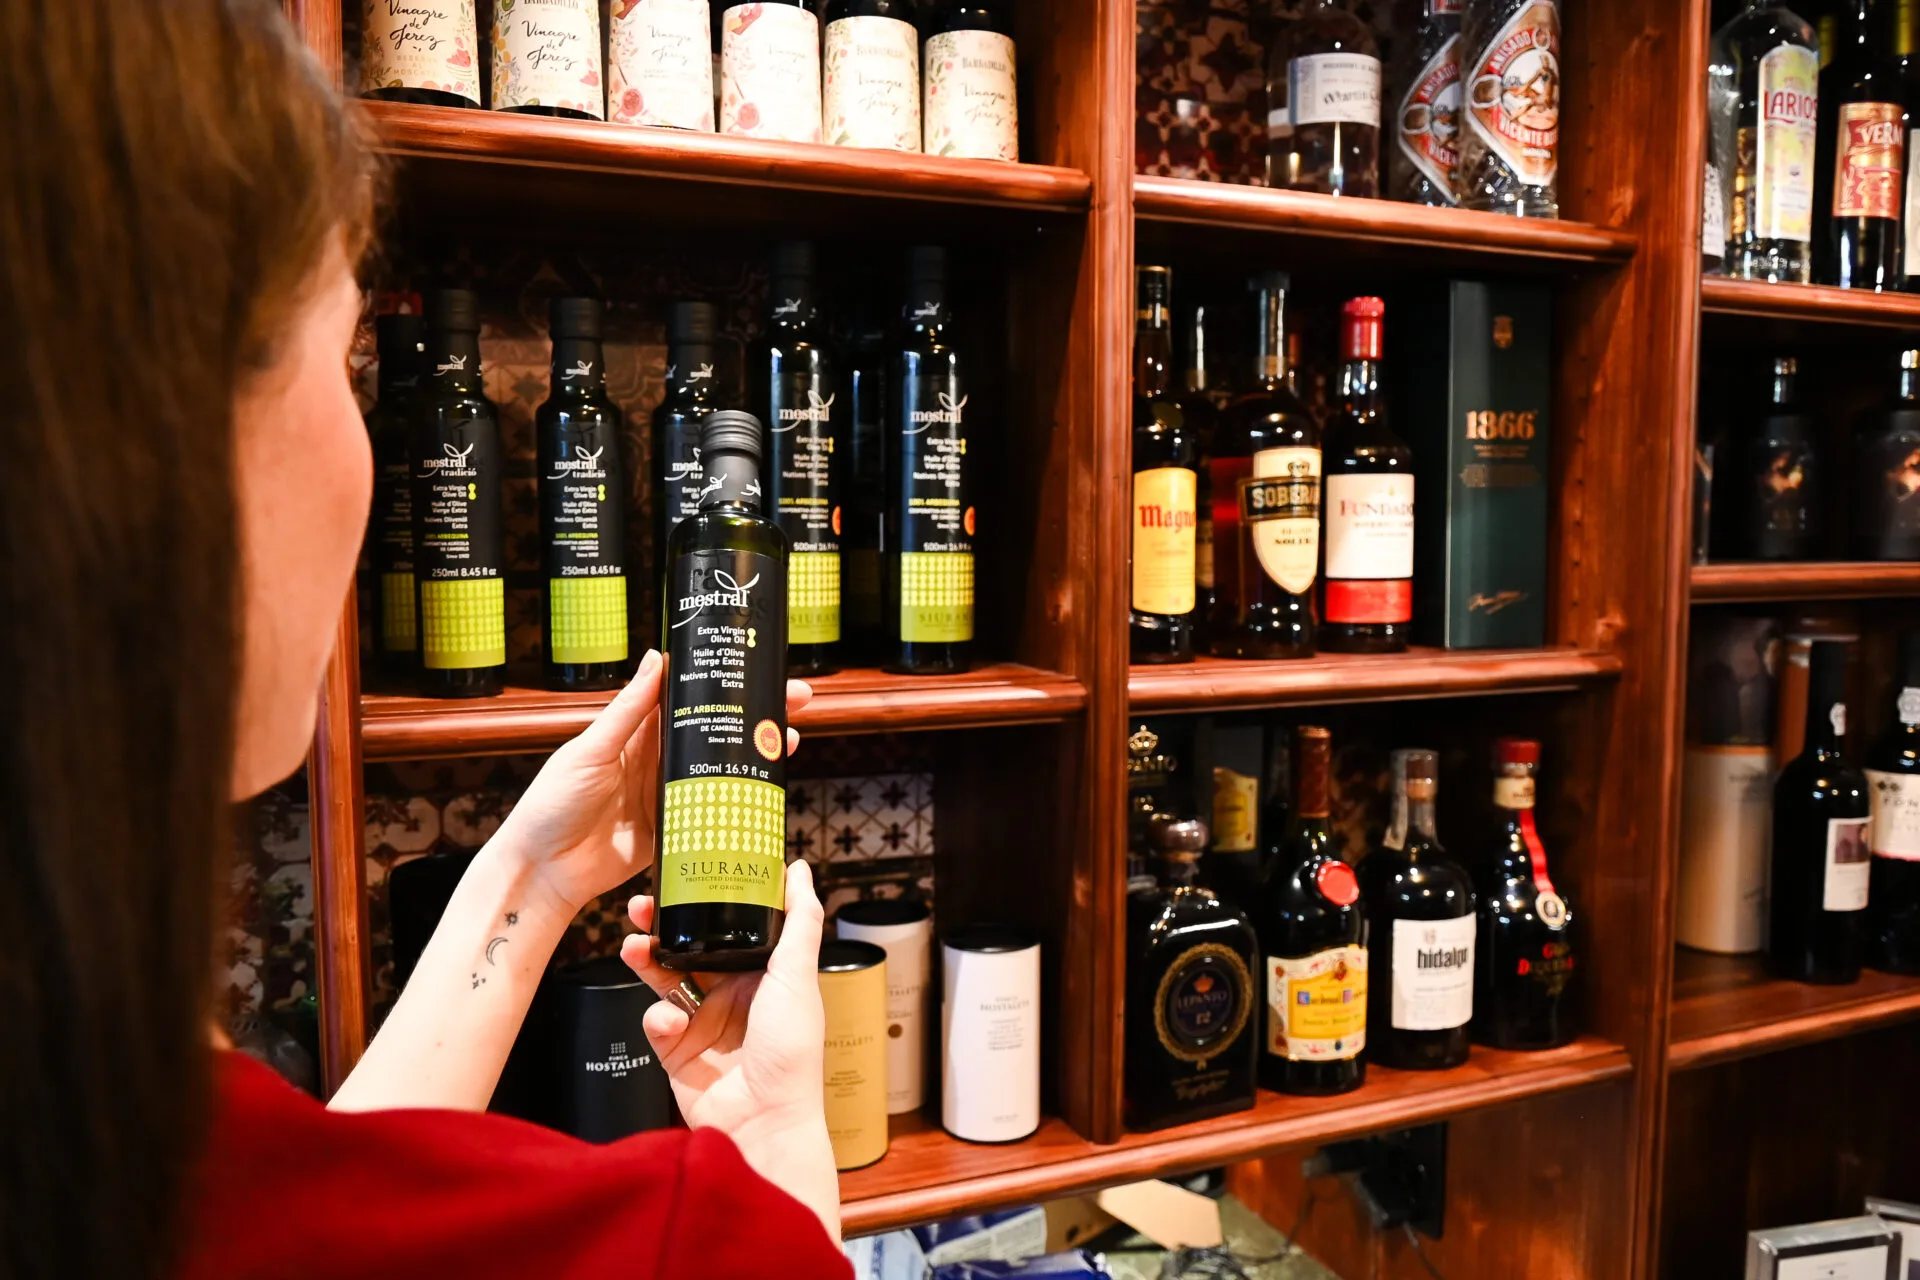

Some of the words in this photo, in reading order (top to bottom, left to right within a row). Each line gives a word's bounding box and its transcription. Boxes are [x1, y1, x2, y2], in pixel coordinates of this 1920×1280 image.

[384, 0, 448, 26] Vinagre
[521, 20, 581, 47] Vinagre
[778, 407, 830, 422] mestral
[910, 409, 962, 424] mestral
[1466, 409, 1535, 440] 1866
[423, 455, 467, 468] mestral
[554, 458, 598, 470] mestral
[441, 467, 477, 477] tradició
[432, 568, 459, 577] 250ml
[460, 566, 482, 577] 8.45
[561, 565, 588, 576] 250ml
[590, 565, 609, 575] 8.45
[679, 589, 750, 612] mestral
[697, 626, 719, 635] Extra
[720, 626, 745, 637] Virgin
[710, 635, 732, 644] Olive
[733, 635, 745, 645] Oil
[693, 649, 714, 658] Huile
[716, 648, 745, 658] d'Olive
[693, 658, 720, 667] Vierge
[722, 657, 745, 667] Extra
[680, 670, 708, 682] Natives
[710, 669, 745, 680] Olivenöl
[721, 679, 744, 689] Extra
[673, 706, 692, 718] 100%
[693, 704, 744, 714] ARBEQUINA
[673, 716, 712, 728] COOPERATIVA
[712, 715, 744, 725] AGRÍCOLA
[700, 724, 710, 732] DE
[710, 724, 744, 733] CAMBRILS
[708, 736, 726, 744] Since
[726, 736, 743, 744] 1902
[689, 763, 722, 775] 500ml
[724, 763, 749, 775] 16.9
[751, 765, 758, 777] fl
[759, 769, 769, 779] oz
[680, 860, 770, 880] SIURANA
[685, 875, 723, 884] PROTECTED
[824, 1036, 874, 1048] OSTALETS
[585, 1055, 651, 1072] HOSTALETS
